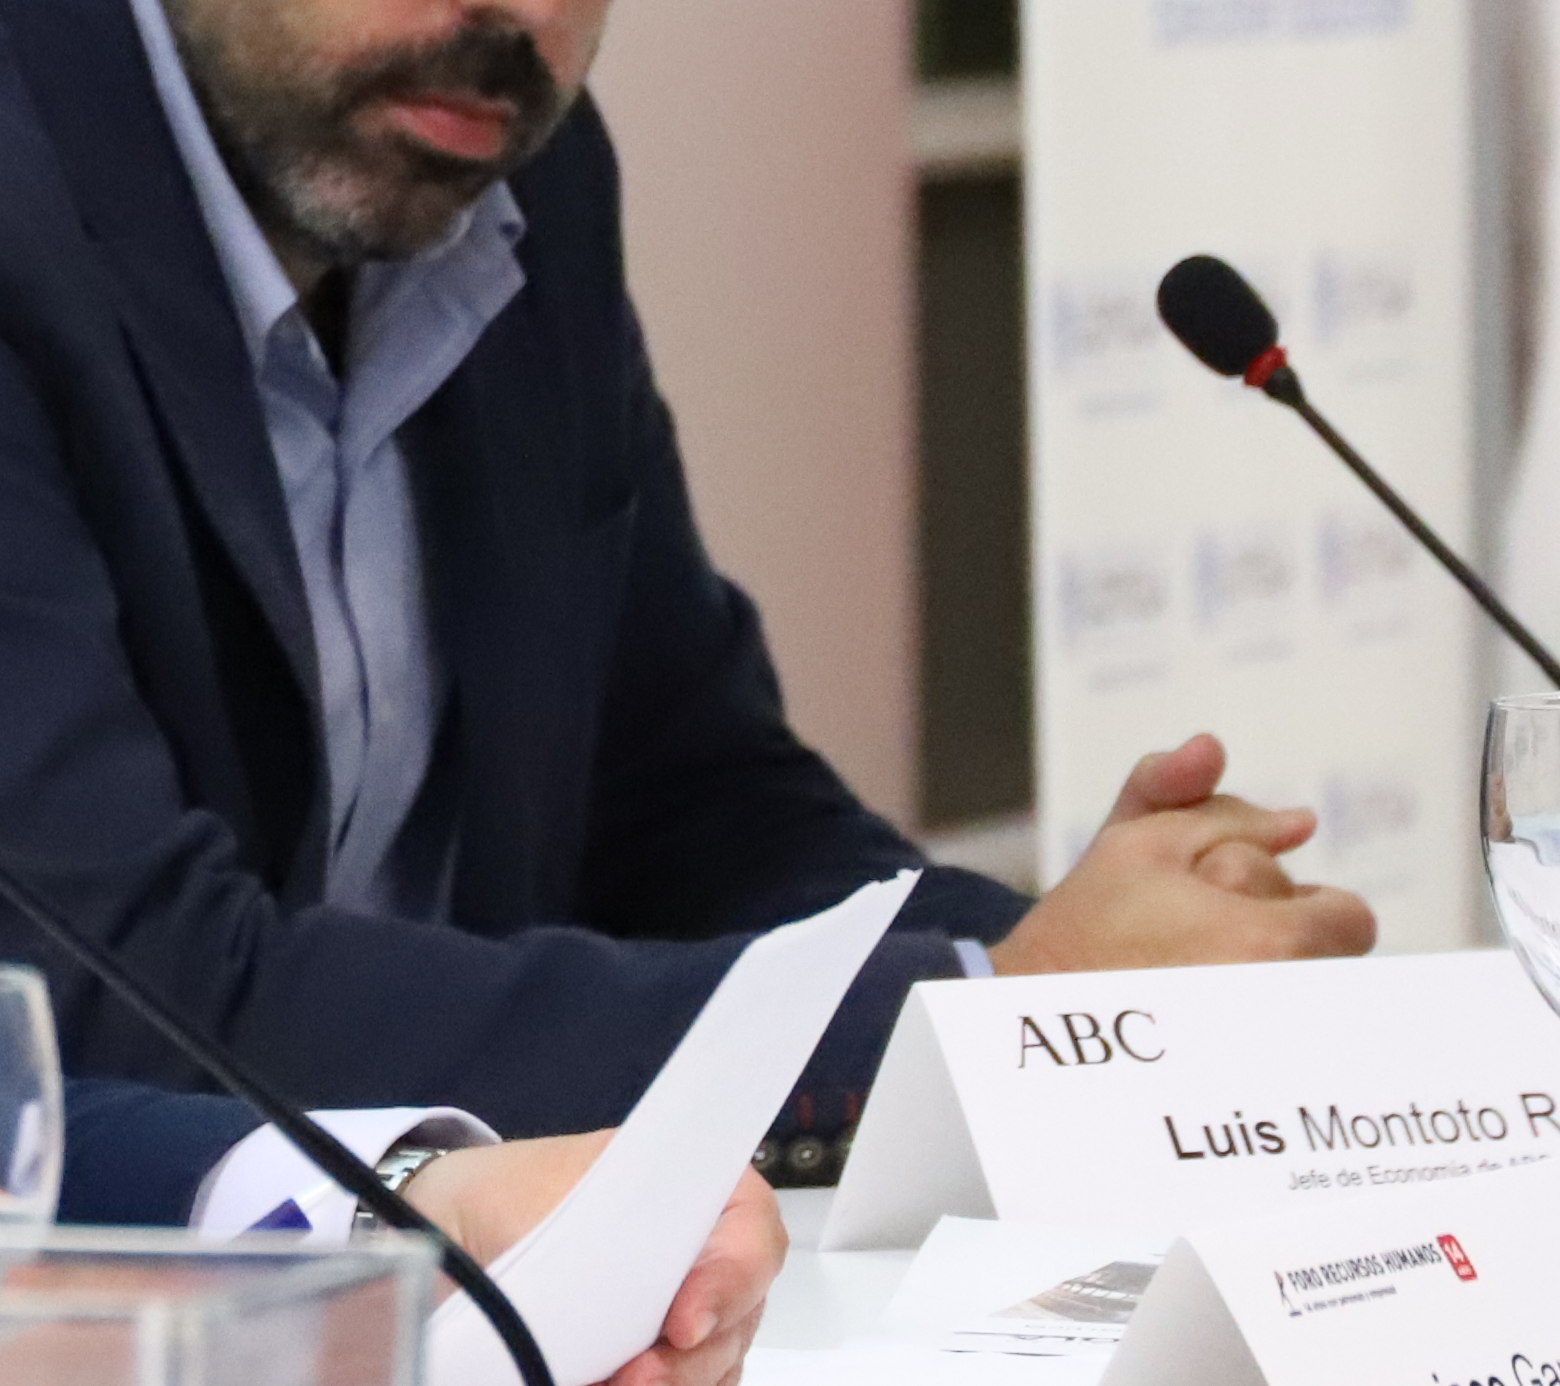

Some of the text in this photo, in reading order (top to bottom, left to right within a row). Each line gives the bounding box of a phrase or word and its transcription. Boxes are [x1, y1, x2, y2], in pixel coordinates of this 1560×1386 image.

[1018, 1010, 1166, 1069] ABC
[1164, 1111, 1286, 1161] Luis
[1297, 1098, 1509, 1153] Montoto
[1288, 1169, 1331, 1191] Jefe
[1336, 1167, 1363, 1188] de
[1287, 1266, 1324, 1293] FORO
[1320, 1253, 1386, 1285] RECURSOS
[1380, 1242, 1443, 1275] HUMANOS
